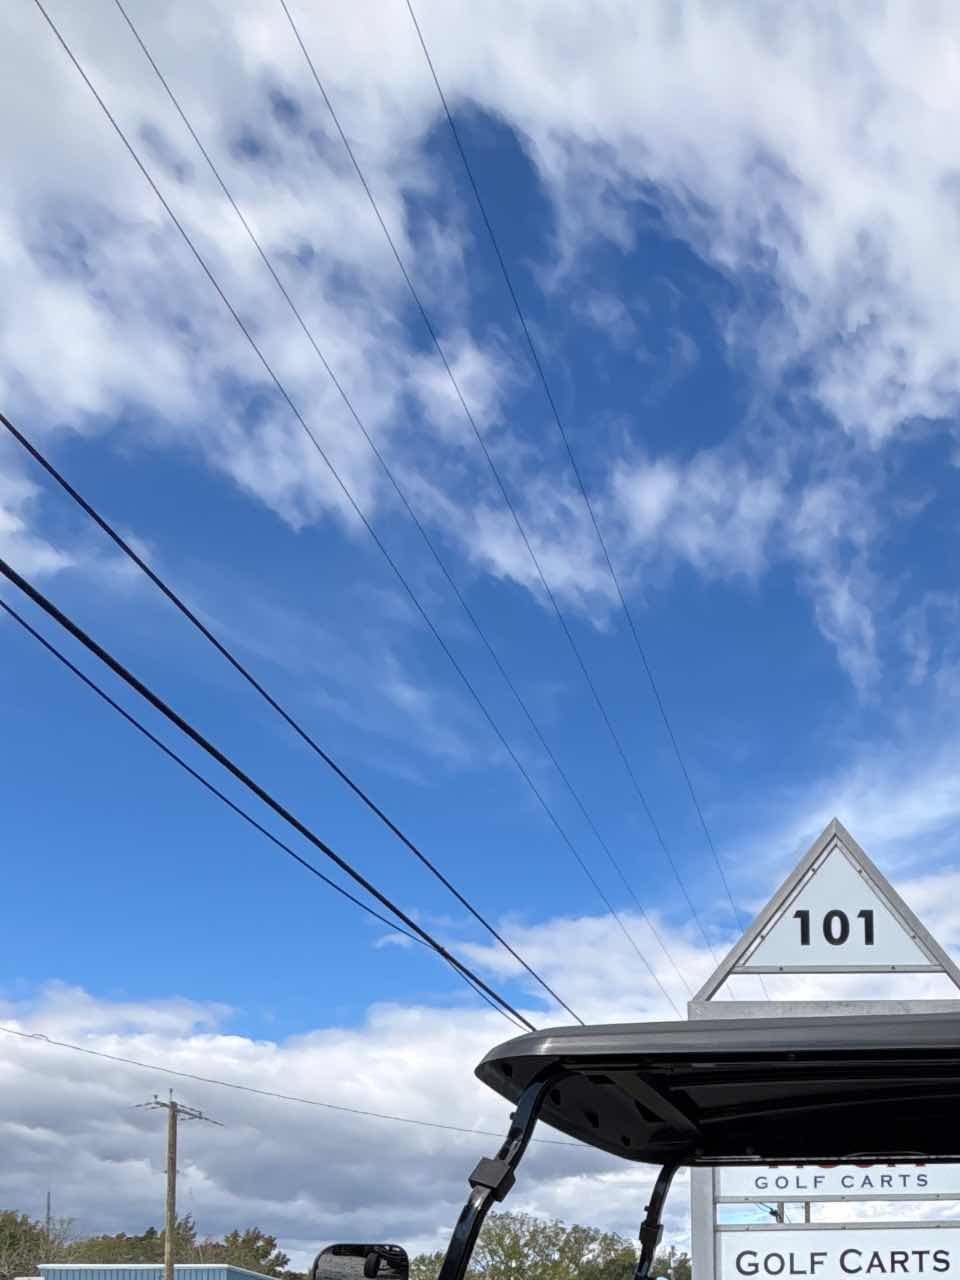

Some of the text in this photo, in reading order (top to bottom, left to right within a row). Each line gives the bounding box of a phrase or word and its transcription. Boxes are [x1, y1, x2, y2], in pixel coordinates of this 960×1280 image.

[793, 910, 875, 946] 101
[754, 1173, 929, 1190] GOLF CARTS
[735, 1248, 951, 1276] GOLF CARTS
